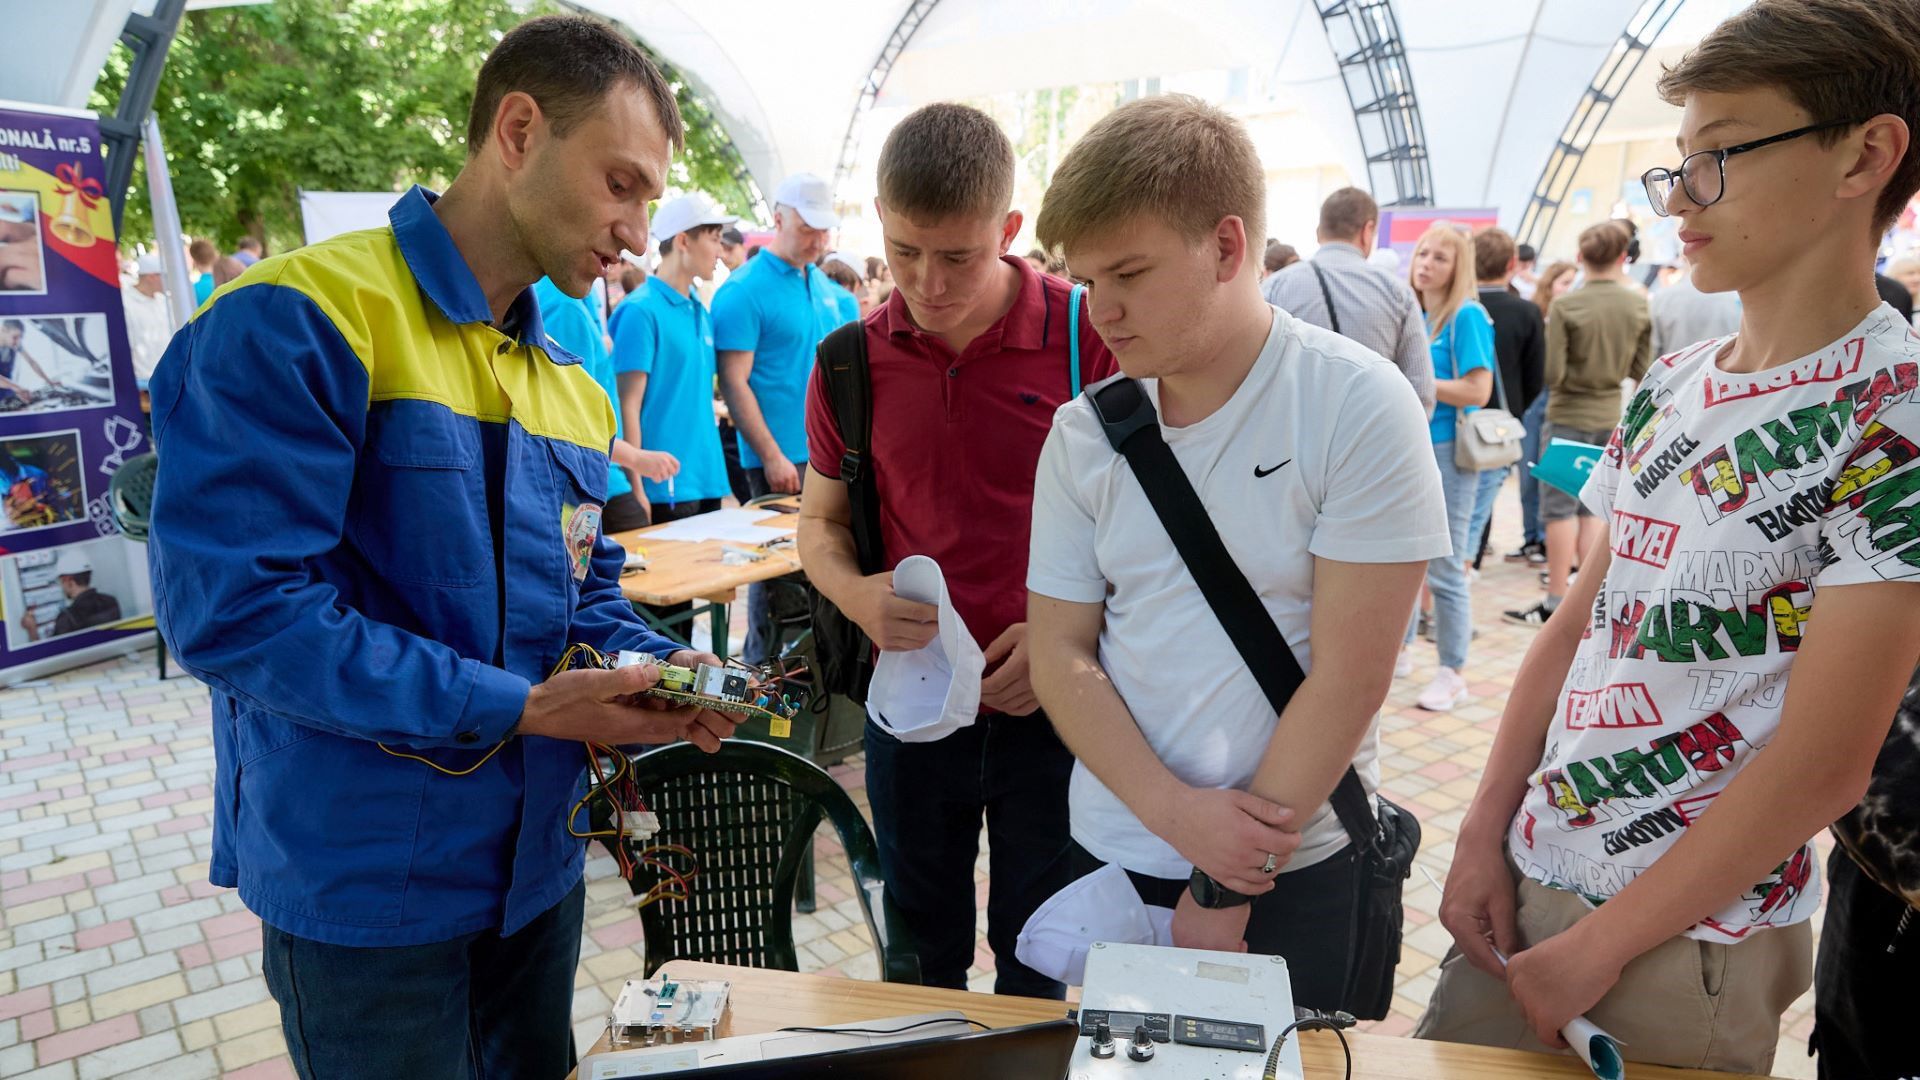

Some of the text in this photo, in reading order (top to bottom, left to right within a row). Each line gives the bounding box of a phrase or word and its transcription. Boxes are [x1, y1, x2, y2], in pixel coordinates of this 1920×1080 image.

[57, 136, 91, 154] nr.5
[1633, 432, 1700, 499] MARVEL
[1671, 545, 1820, 591] MARVE
[1608, 577, 1818, 662] MARVE
[1570, 686, 1656, 728] MARVEL
[1688, 669, 1790, 711] RVEL
[1602, 807, 1686, 856] MARVEL
